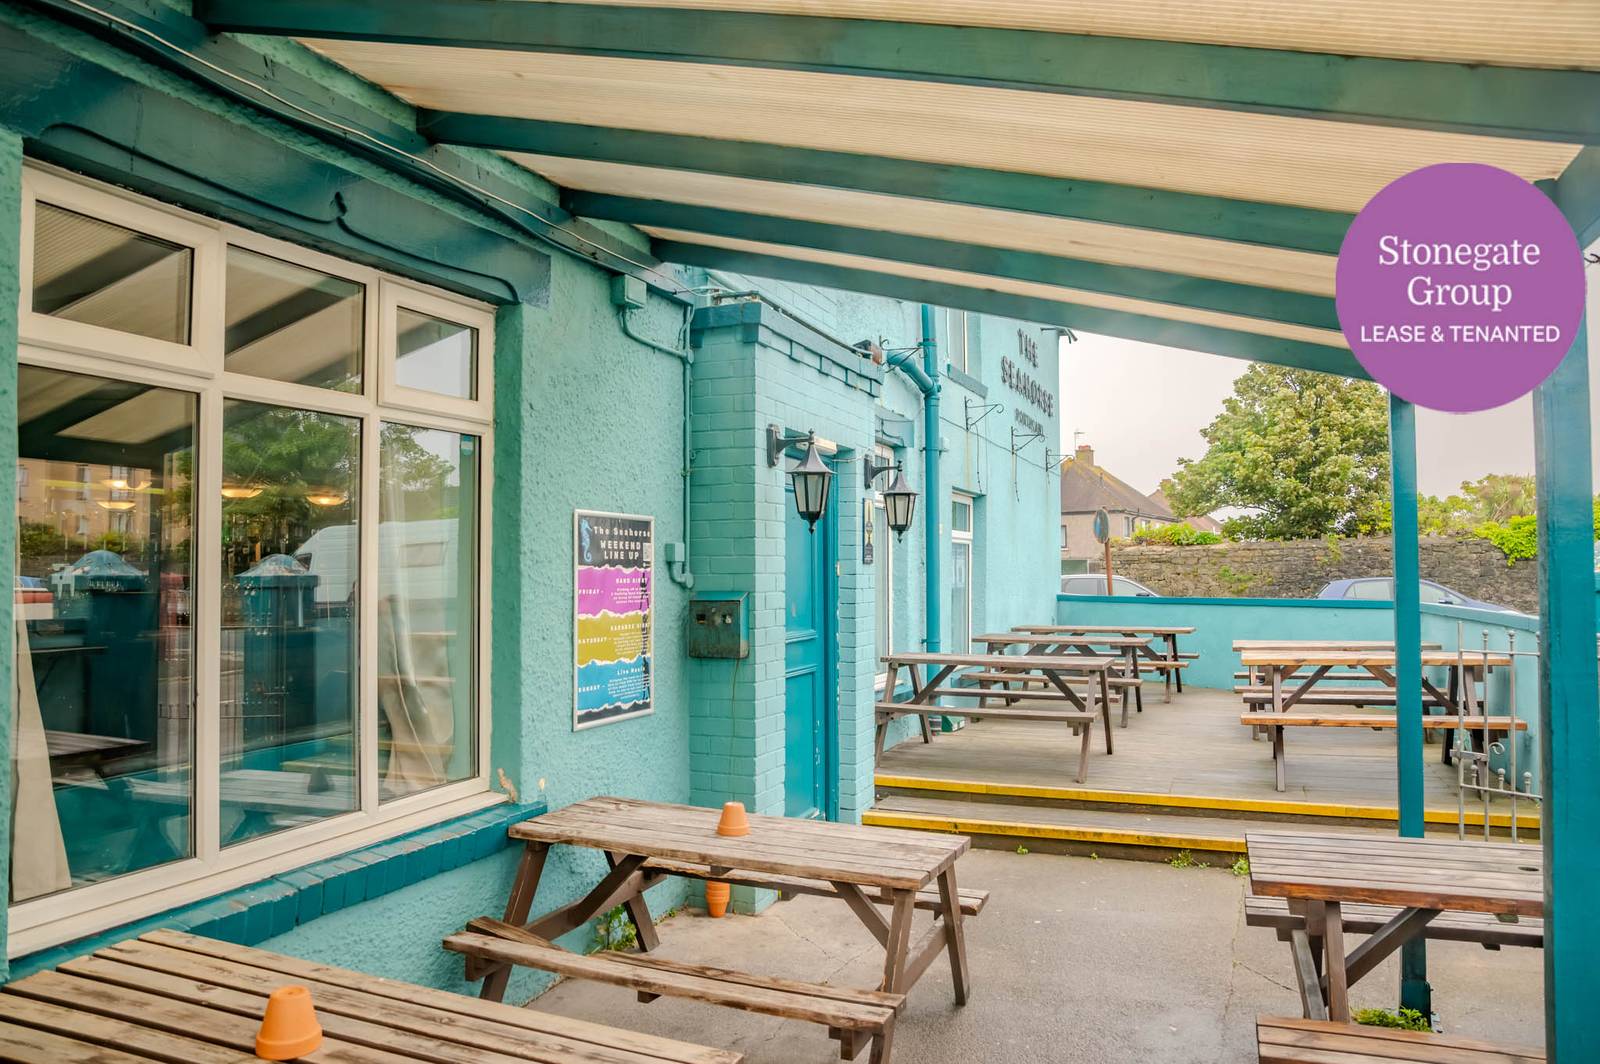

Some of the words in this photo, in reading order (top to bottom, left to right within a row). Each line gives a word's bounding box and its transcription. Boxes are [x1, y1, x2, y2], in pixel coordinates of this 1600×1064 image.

[1017, 328, 1039, 368] THE
[1001, 355, 1053, 418] SEAHORSE
[593, 526, 610, 535] The
[613, 527, 651, 538] Seahorse
[600, 539, 641, 550] WEEKEND
[604, 550, 625, 560] LINE
[628, 551, 639, 560] UP
